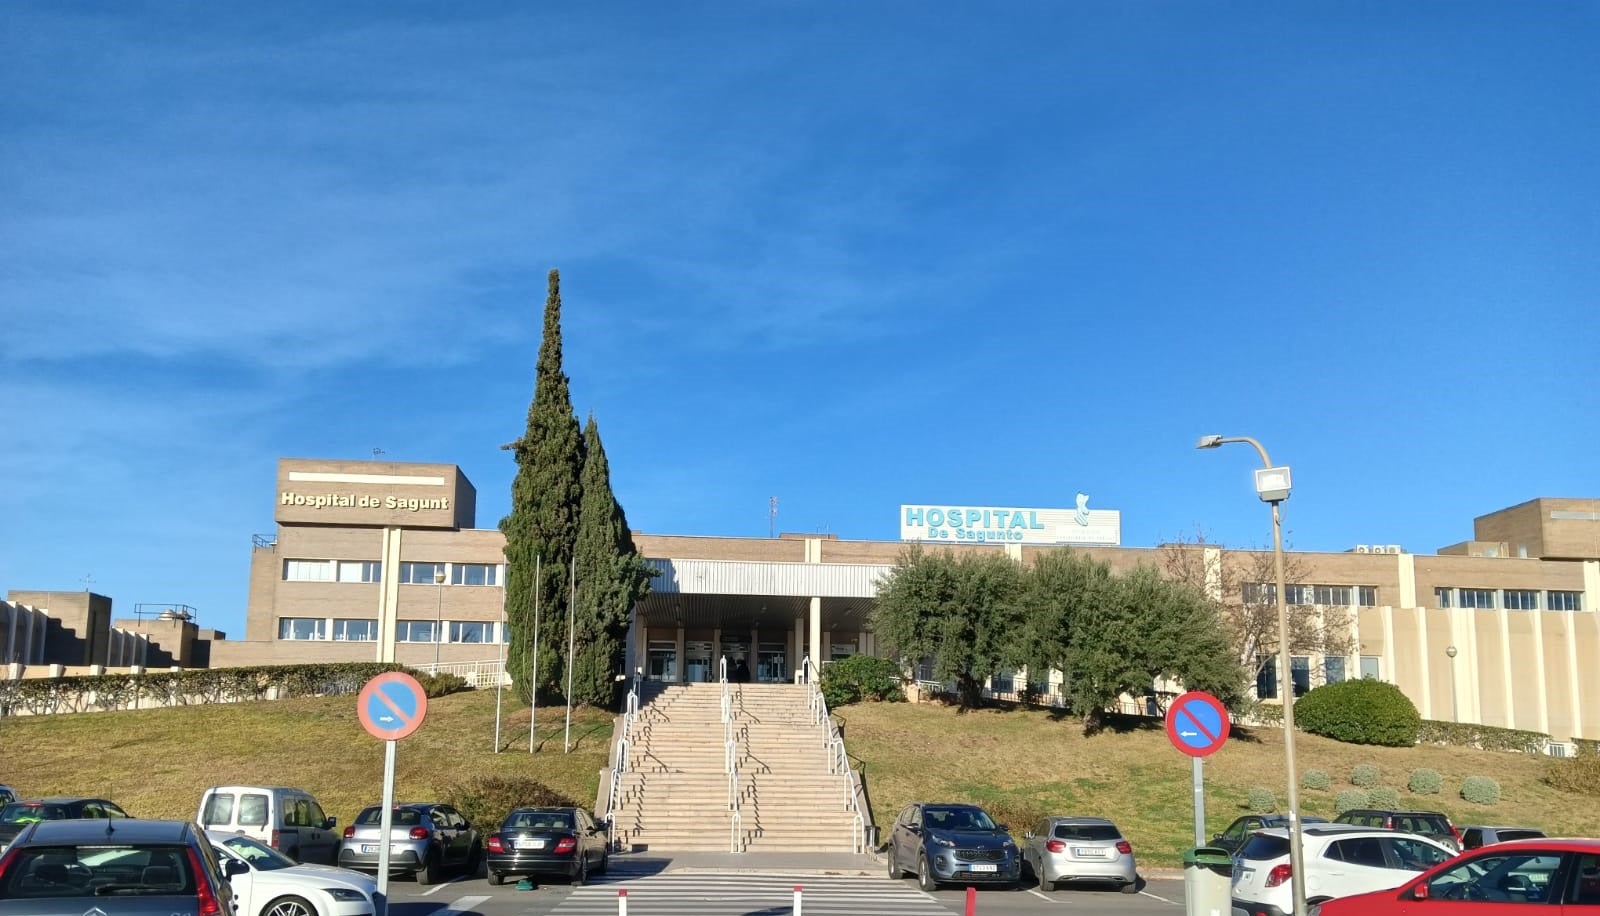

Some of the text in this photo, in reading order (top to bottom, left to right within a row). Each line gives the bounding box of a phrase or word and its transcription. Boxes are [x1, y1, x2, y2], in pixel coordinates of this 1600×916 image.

[281, 492, 449, 512] Hospital de Sagunt
[906, 507, 1045, 530] HOSPITAL
[928, 526, 1024, 542] De Sagunto
